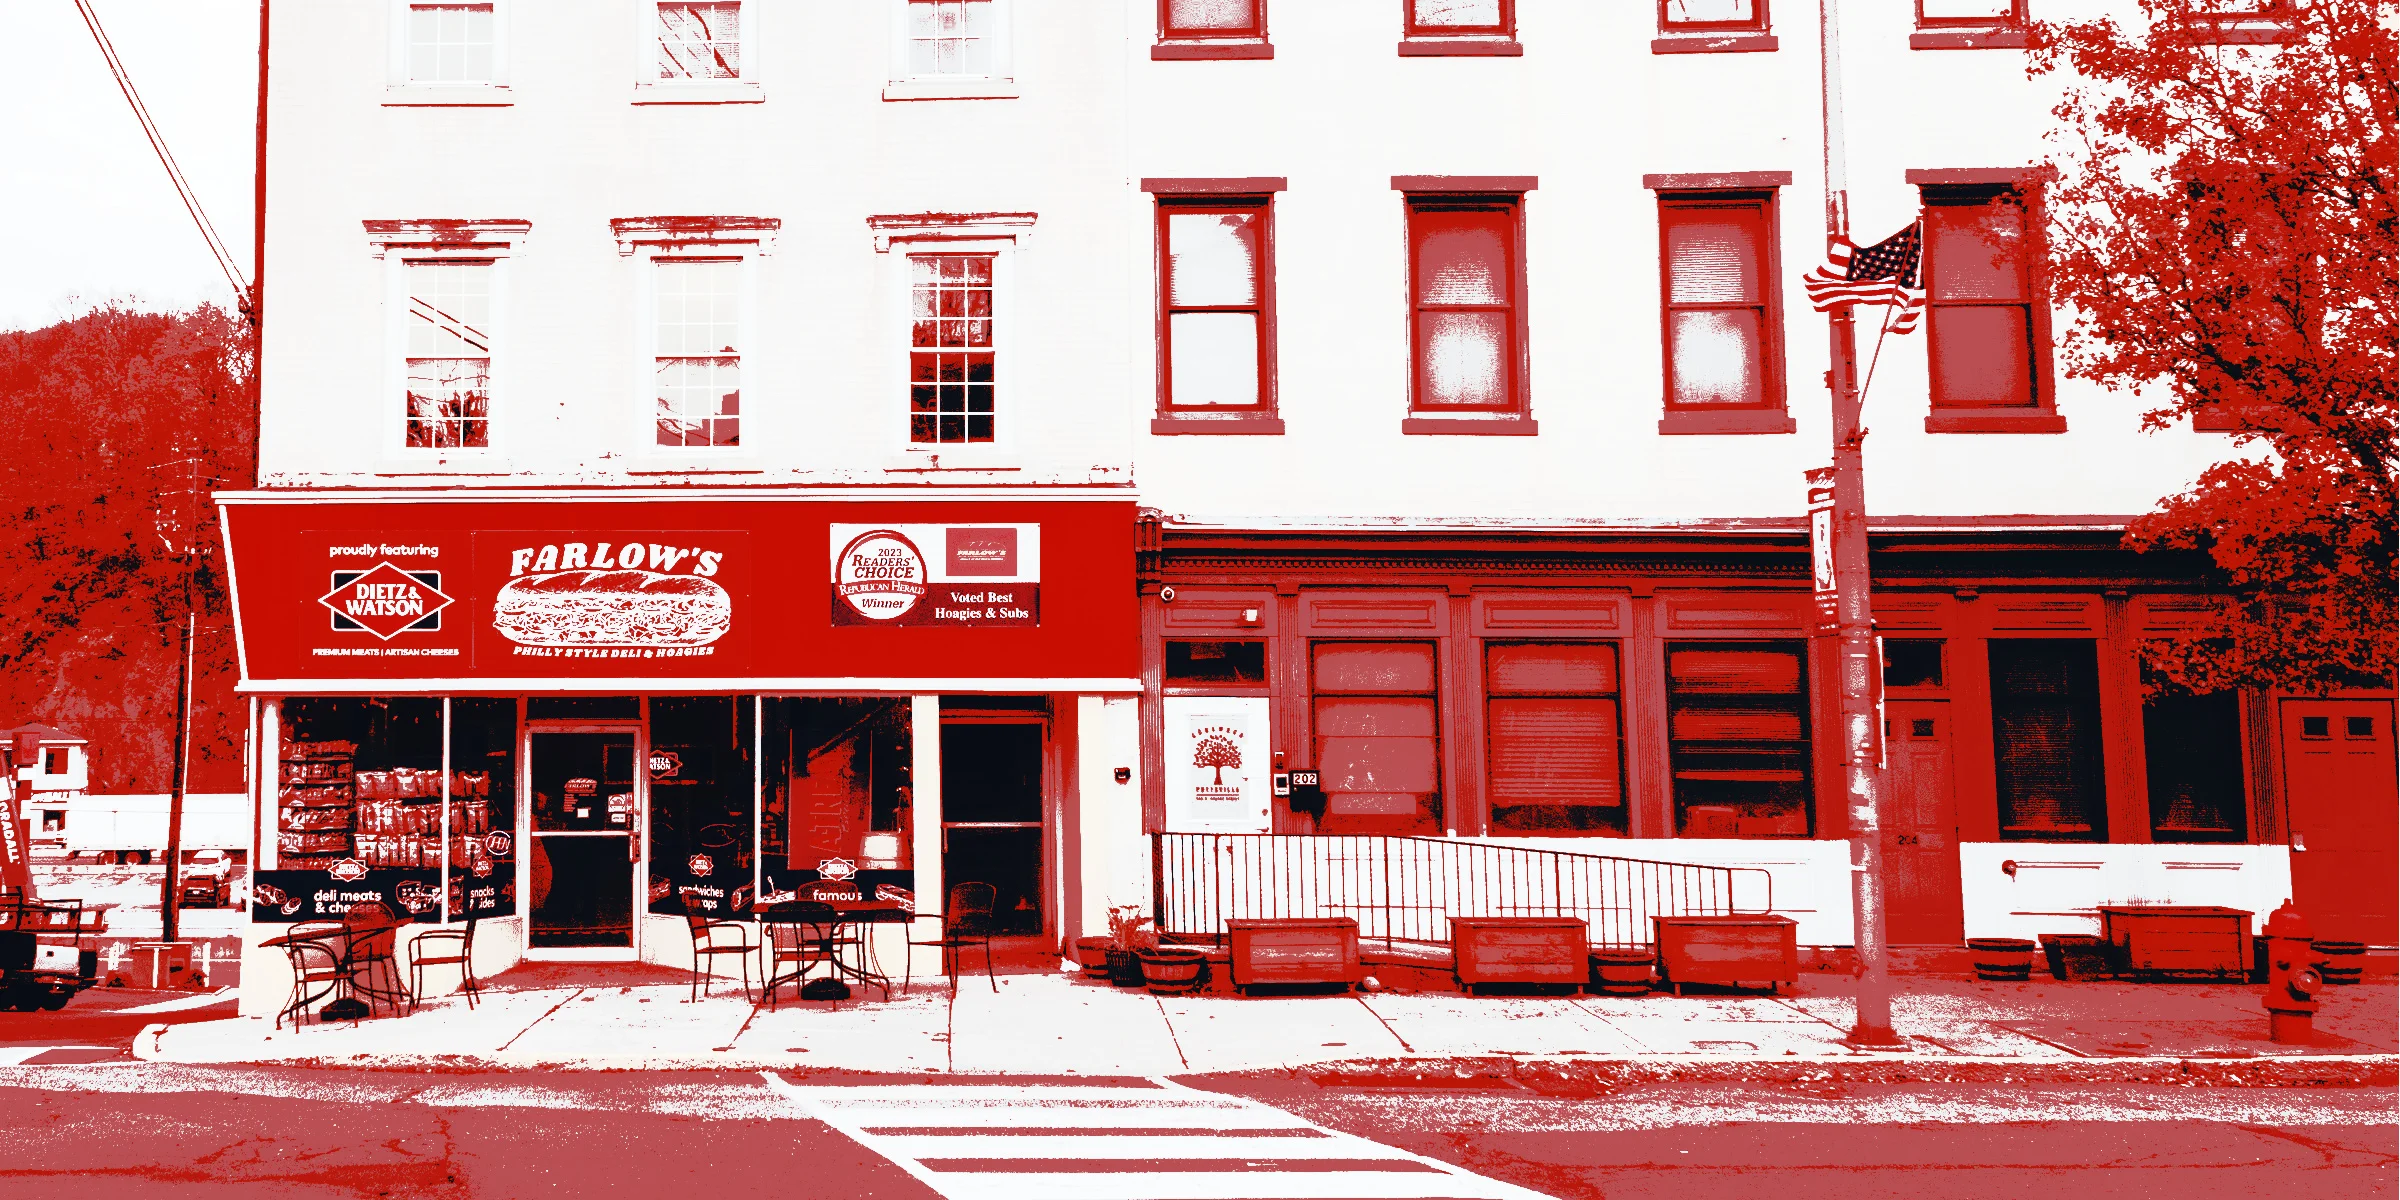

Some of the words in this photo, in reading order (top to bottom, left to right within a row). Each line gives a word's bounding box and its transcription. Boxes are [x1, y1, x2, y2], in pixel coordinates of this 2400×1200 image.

[330, 544, 377, 557] proudly
[380, 544, 438, 557] featuring
[510, 543, 722, 577] FARLOW'S
[855, 567, 914, 578] CHOICE
[357, 584, 407, 599] DIETZ
[951, 592, 983, 602] Voted
[988, 592, 1012, 602] Best
[346, 600, 423, 616] WATSON
[862, 599, 904, 608] Winner
[936, 608, 981, 620] Hoagies
[986, 608, 996, 618] &
[1000, 608, 1028, 618] Subs
[513, 647, 563, 656] PHILLY
[564, 648, 609, 658] STYLE
[611, 649, 641, 658] DELI
[644, 650, 653, 658] &
[656, 647, 714, 657] HOAGIES
[650, 763, 671, 771] ATSON
[1294, 774, 1316, 784] 202
[314, 890, 336, 901] deli
[341, 891, 381, 901] meats
[470, 885, 495, 898] snacks
[813, 889, 862, 901] famous
[316, 902, 325, 913] &
